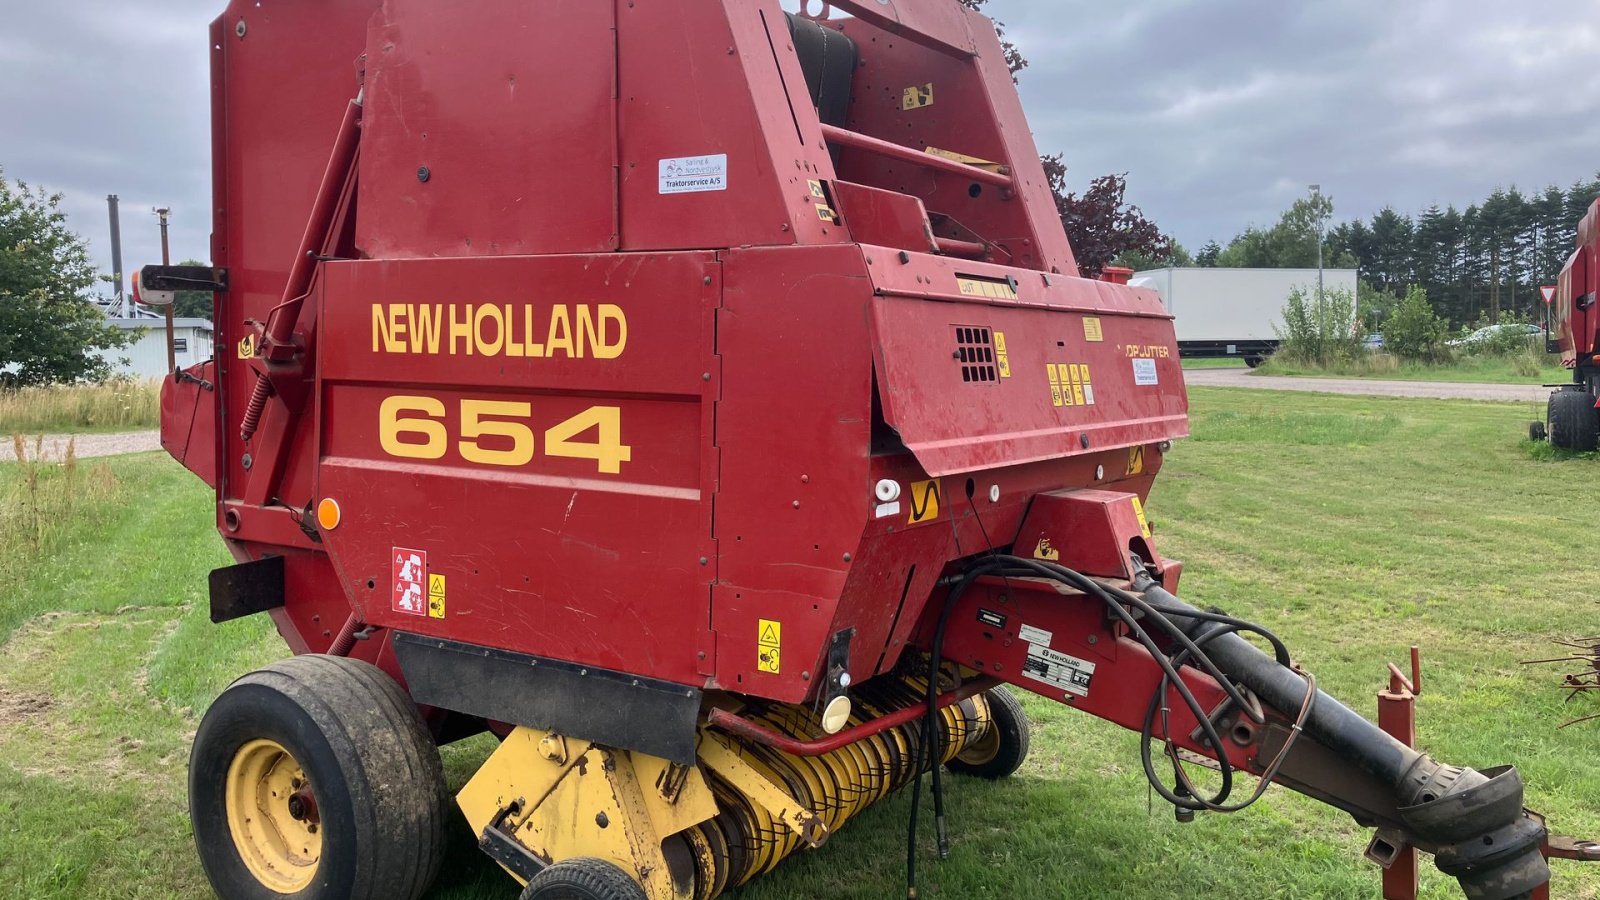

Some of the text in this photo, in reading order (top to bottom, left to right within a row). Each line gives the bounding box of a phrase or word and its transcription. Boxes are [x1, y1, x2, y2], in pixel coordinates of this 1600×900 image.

[666, 177, 721, 187] Traktorservice A/S
[372, 302, 628, 359] NEW HOLLAND
[379, 395, 632, 474] 654
[1049, 653, 1061, 662] NEW
[1060, 656, 1080, 668] HOLLAND
